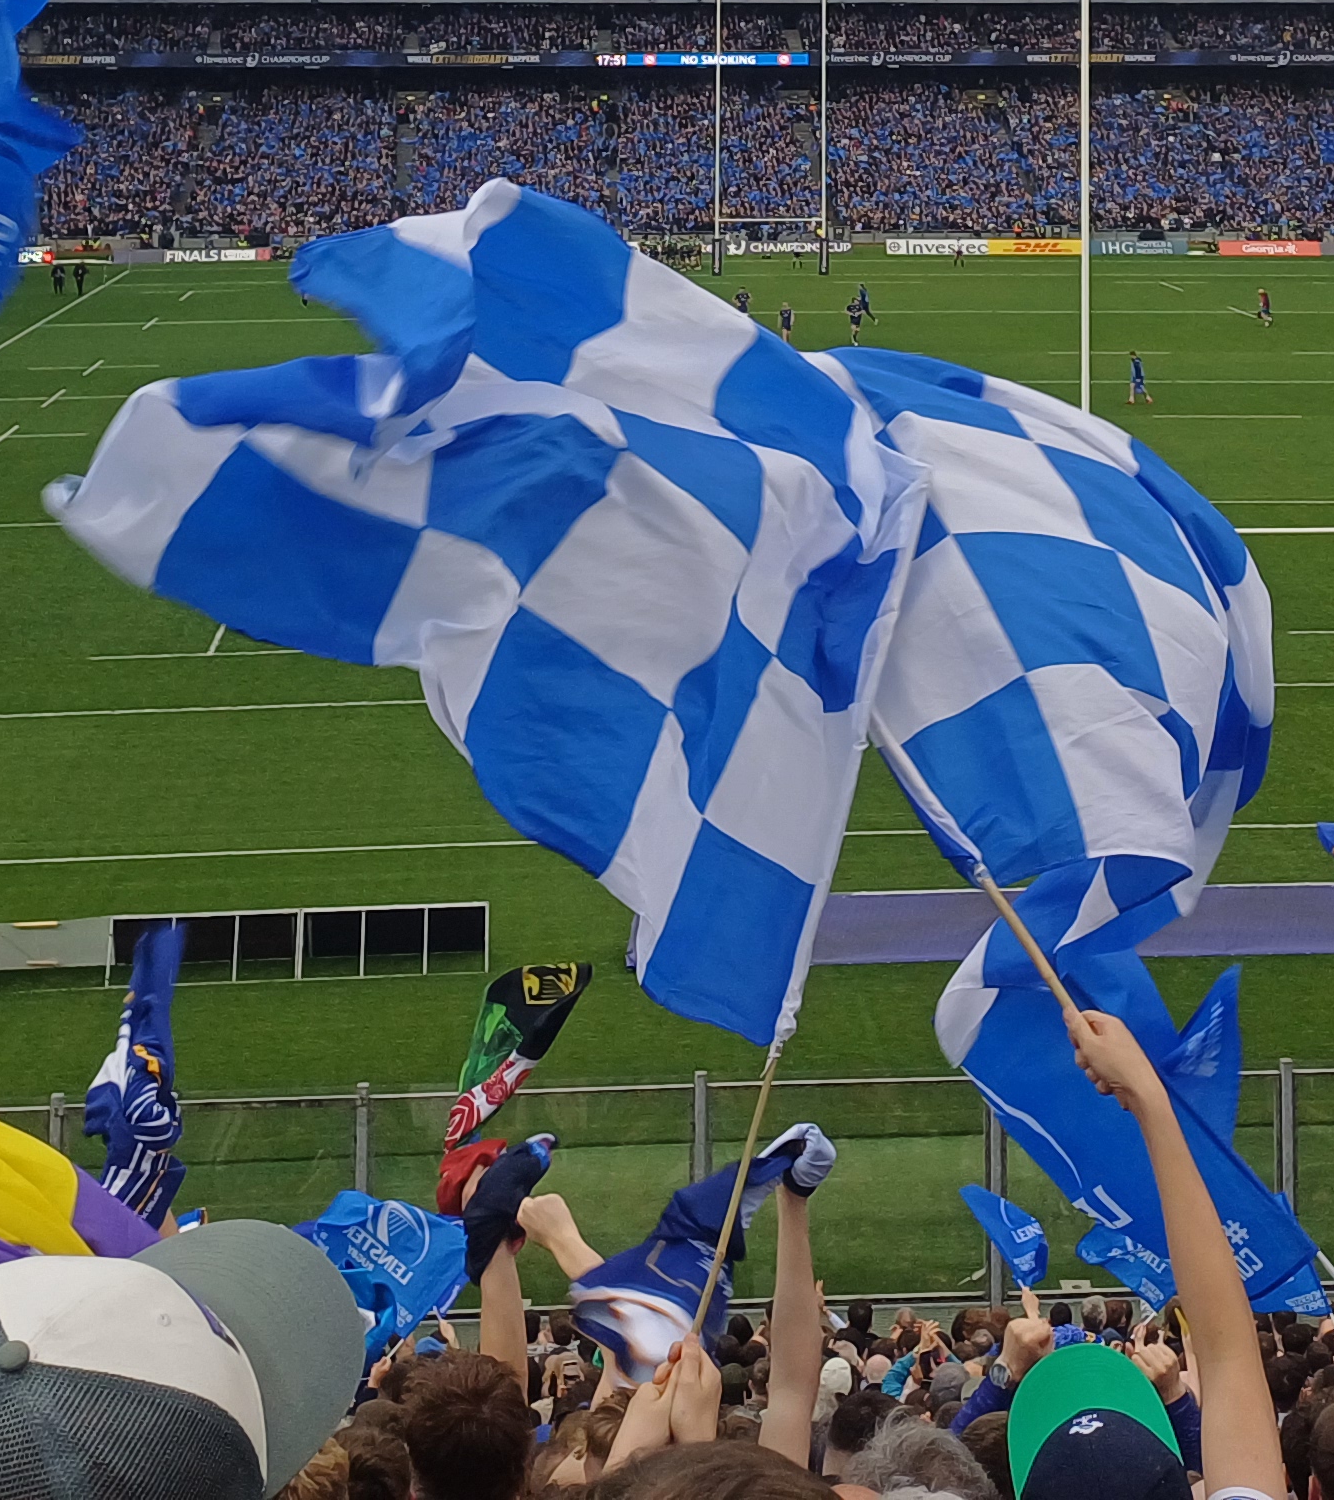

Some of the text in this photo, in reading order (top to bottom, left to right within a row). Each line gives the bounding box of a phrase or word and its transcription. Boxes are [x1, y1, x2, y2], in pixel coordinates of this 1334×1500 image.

[597, 54, 756, 66] 17:51 NO SMOKING
[906, 240, 989, 254] Invesec
[1013, 242, 1062, 253] DHL
[1101, 241, 1135, 255] IHG
[1242, 244, 1285, 255] Georgia
[166, 249, 219, 263] FINALS
